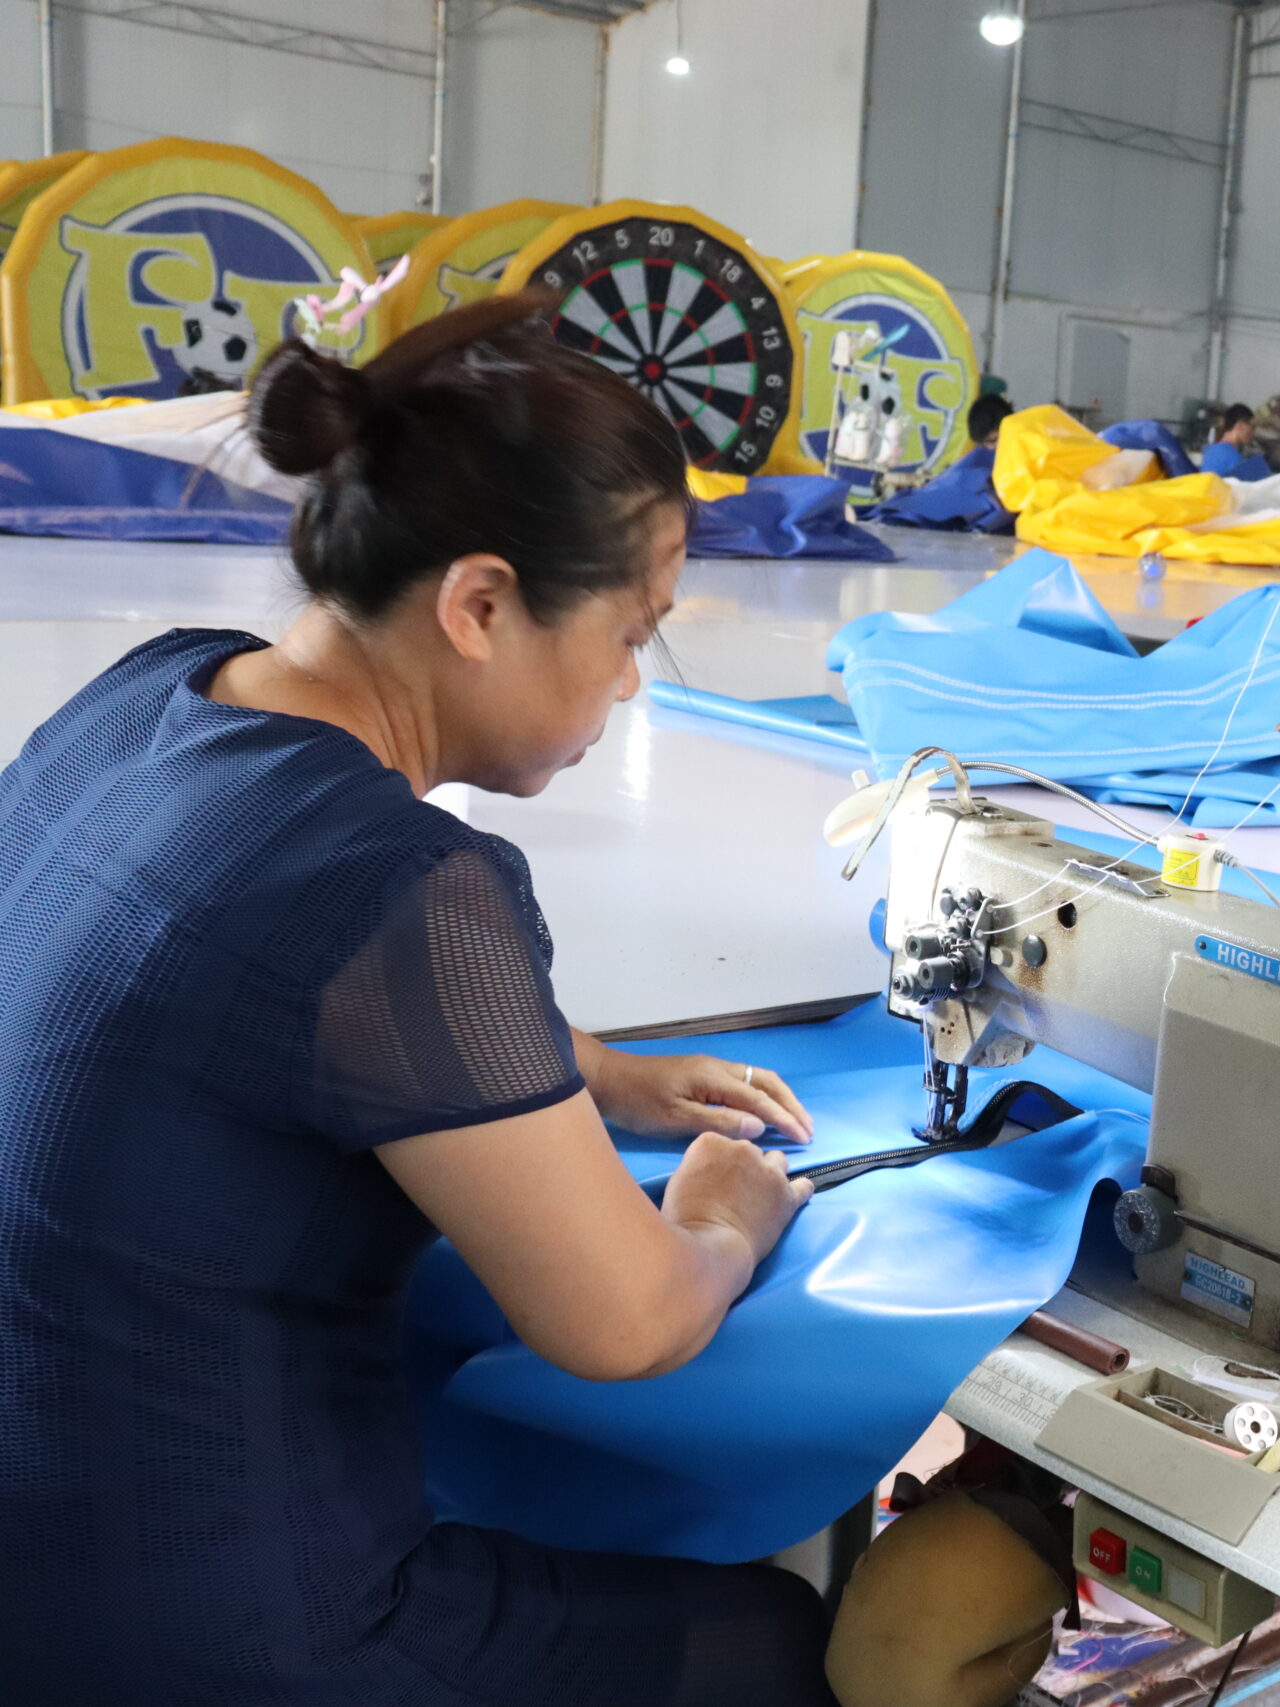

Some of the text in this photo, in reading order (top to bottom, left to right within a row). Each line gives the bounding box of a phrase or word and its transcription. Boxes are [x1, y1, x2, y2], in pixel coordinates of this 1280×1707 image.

[614, 229, 630, 248] 5
[649, 226, 674, 246] 20
[572, 240, 598, 264] 12
[694, 239, 705, 253] 1
[544, 270, 562, 287] 9
[720, 258, 743, 283] 18
[750, 296, 765, 310] 4
[762, 328, 781, 350] 13
[765, 374, 783, 388] 6
[755, 406, 777, 429] 10
[735, 441, 758, 463] 15
[1190, 1257, 1245, 1289] HIGHLEAD
[1092, 1547, 1111, 1563] OFF
[1135, 1565, 1150, 1580] ON
